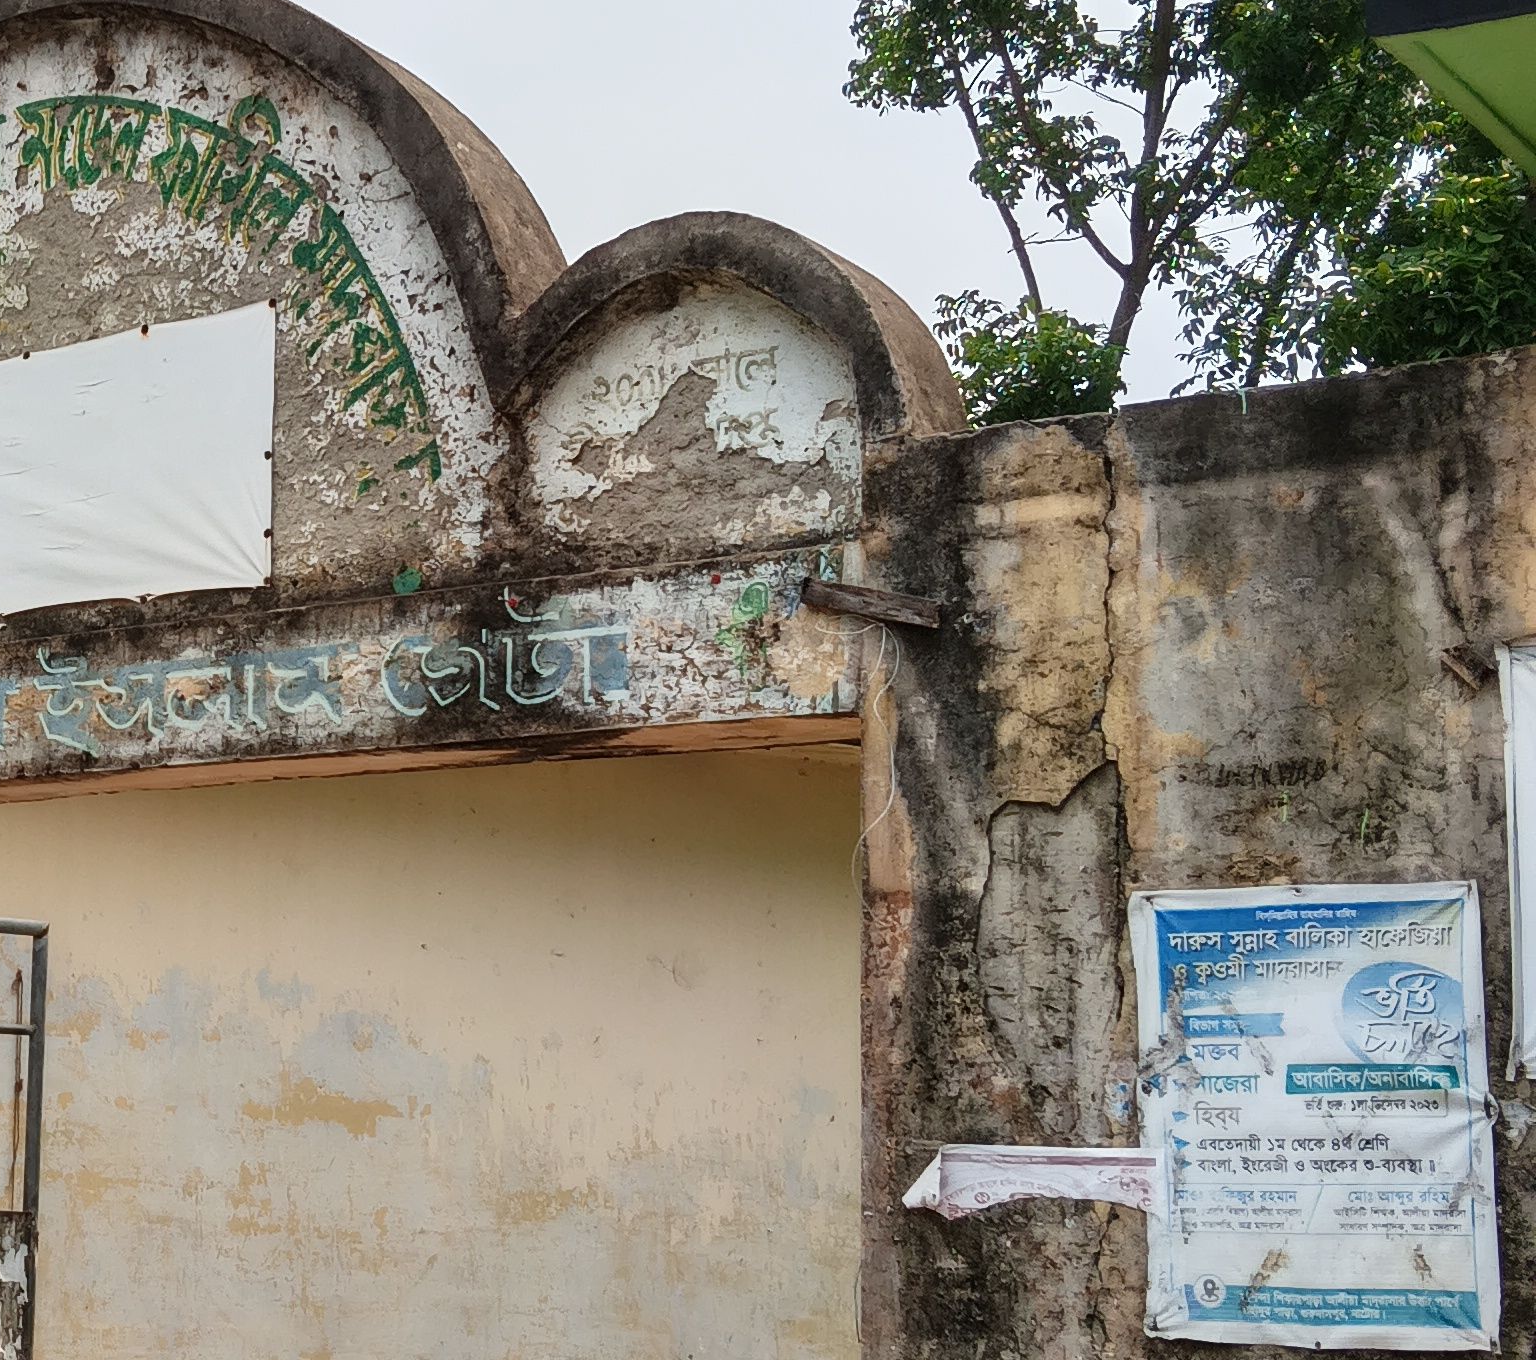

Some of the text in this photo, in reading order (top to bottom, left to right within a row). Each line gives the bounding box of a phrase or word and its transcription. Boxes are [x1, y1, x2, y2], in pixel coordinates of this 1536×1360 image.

[33, 643, 354, 758] ইসলাম
[1167, 921, 1453, 955] দারুস সুন্নাহ বালিকা হাফেজিয়া
[1355, 969, 1445, 1022] ভর্তি
[1189, 1017, 1219, 1032] বিভাগ
[1192, 1043, 1242, 1062] মক্তব
[1410, 1100, 1439, 1112] ২০২৩
[1197, 1133, 1390, 1152] এবতেদায়ী ১ম থেকে ৪র্থ শ্রেণি
[1196, 1158, 1236, 1174] বাংলা,
[1240, 1155, 1288, 1174] ইংরেজী
[1294, 1160, 1305, 1172] ও
[1310, 1160, 1358, 1173] অংকের
[1418, 1187, 1450, 1203] রহিম
